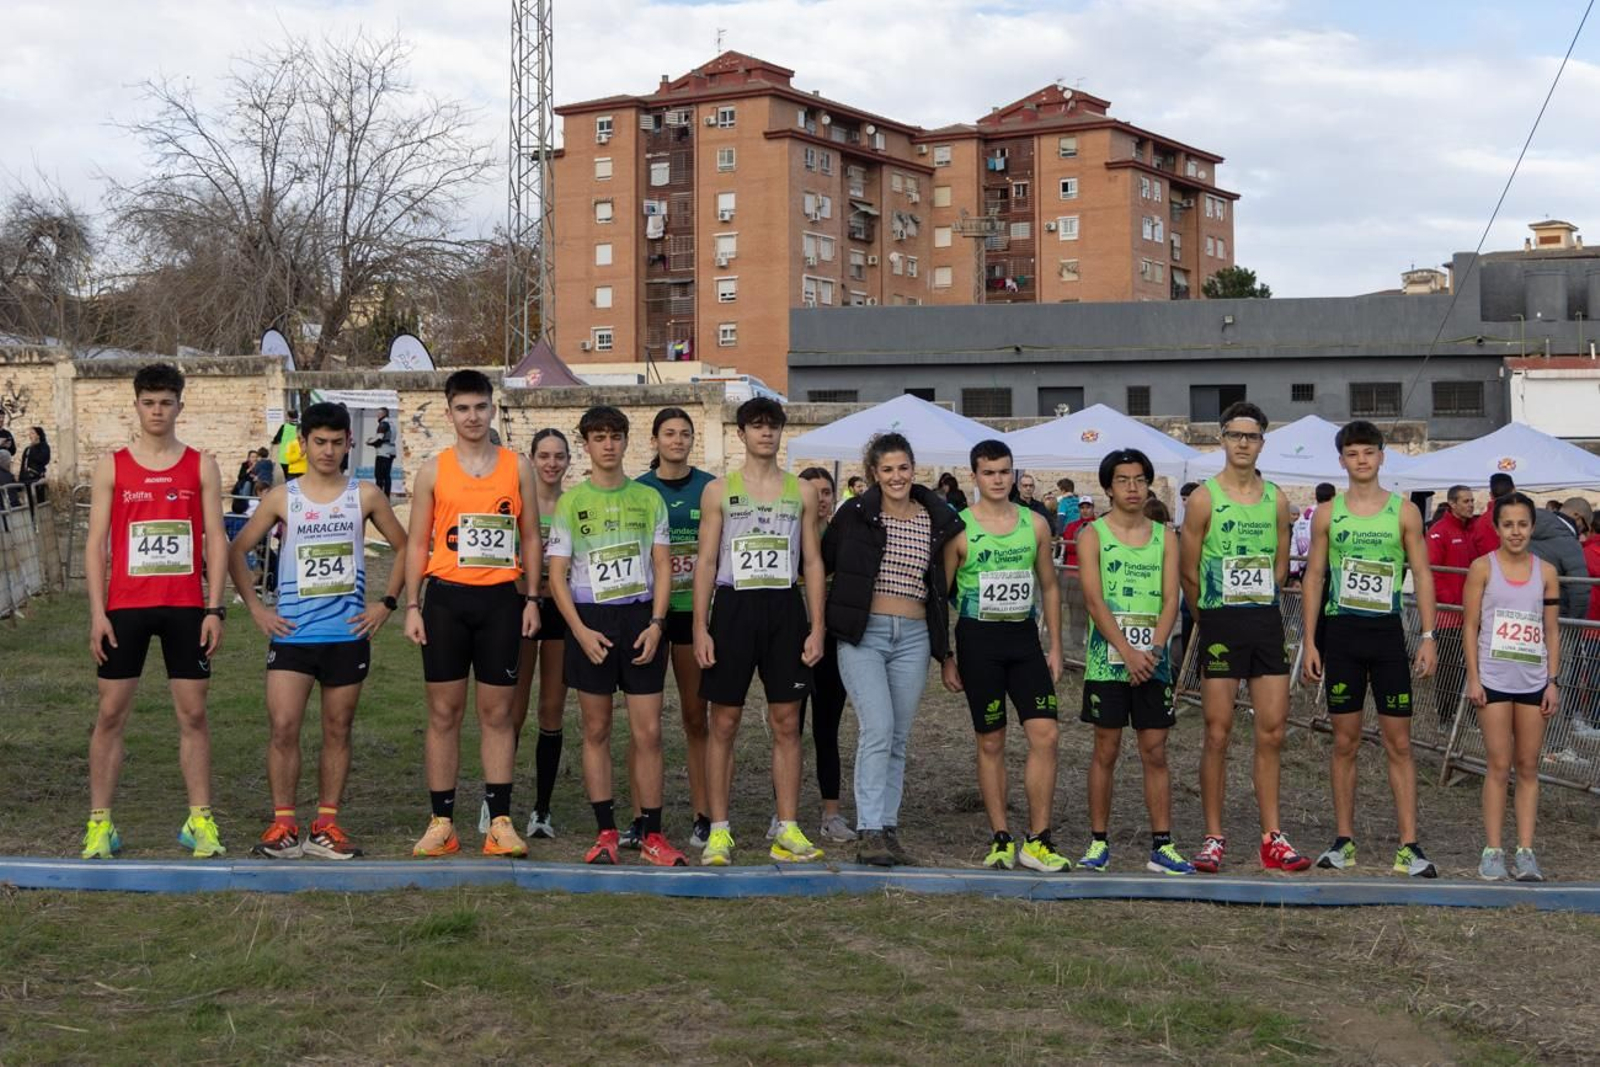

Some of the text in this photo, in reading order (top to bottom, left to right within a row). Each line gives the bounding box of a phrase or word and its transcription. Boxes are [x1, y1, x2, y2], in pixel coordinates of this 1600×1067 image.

[297, 522, 354, 535] MARACENA
[1238, 521, 1272, 529] Fundación
[1238, 528, 1263, 536] Unicaja
[467, 529, 505, 548] 332
[1352, 531, 1393, 539] Fundación
[1352, 538, 1382, 547] Unicaja
[138, 535, 179, 555] 445
[994, 546, 1031, 556] Fundación
[740, 550, 778, 570] 212
[994, 554, 1023, 564] Unicaja
[1124, 561, 1160, 571] Fundación
[305, 556, 345, 578] 254
[596, 557, 633, 582] 217
[1124, 569, 1152, 579] Unicaja
[1230, 569, 1263, 586] 524
[1347, 572, 1383, 593] 553
[983, 582, 1030, 601] 4259
[1496, 621, 1541, 644] 4258
